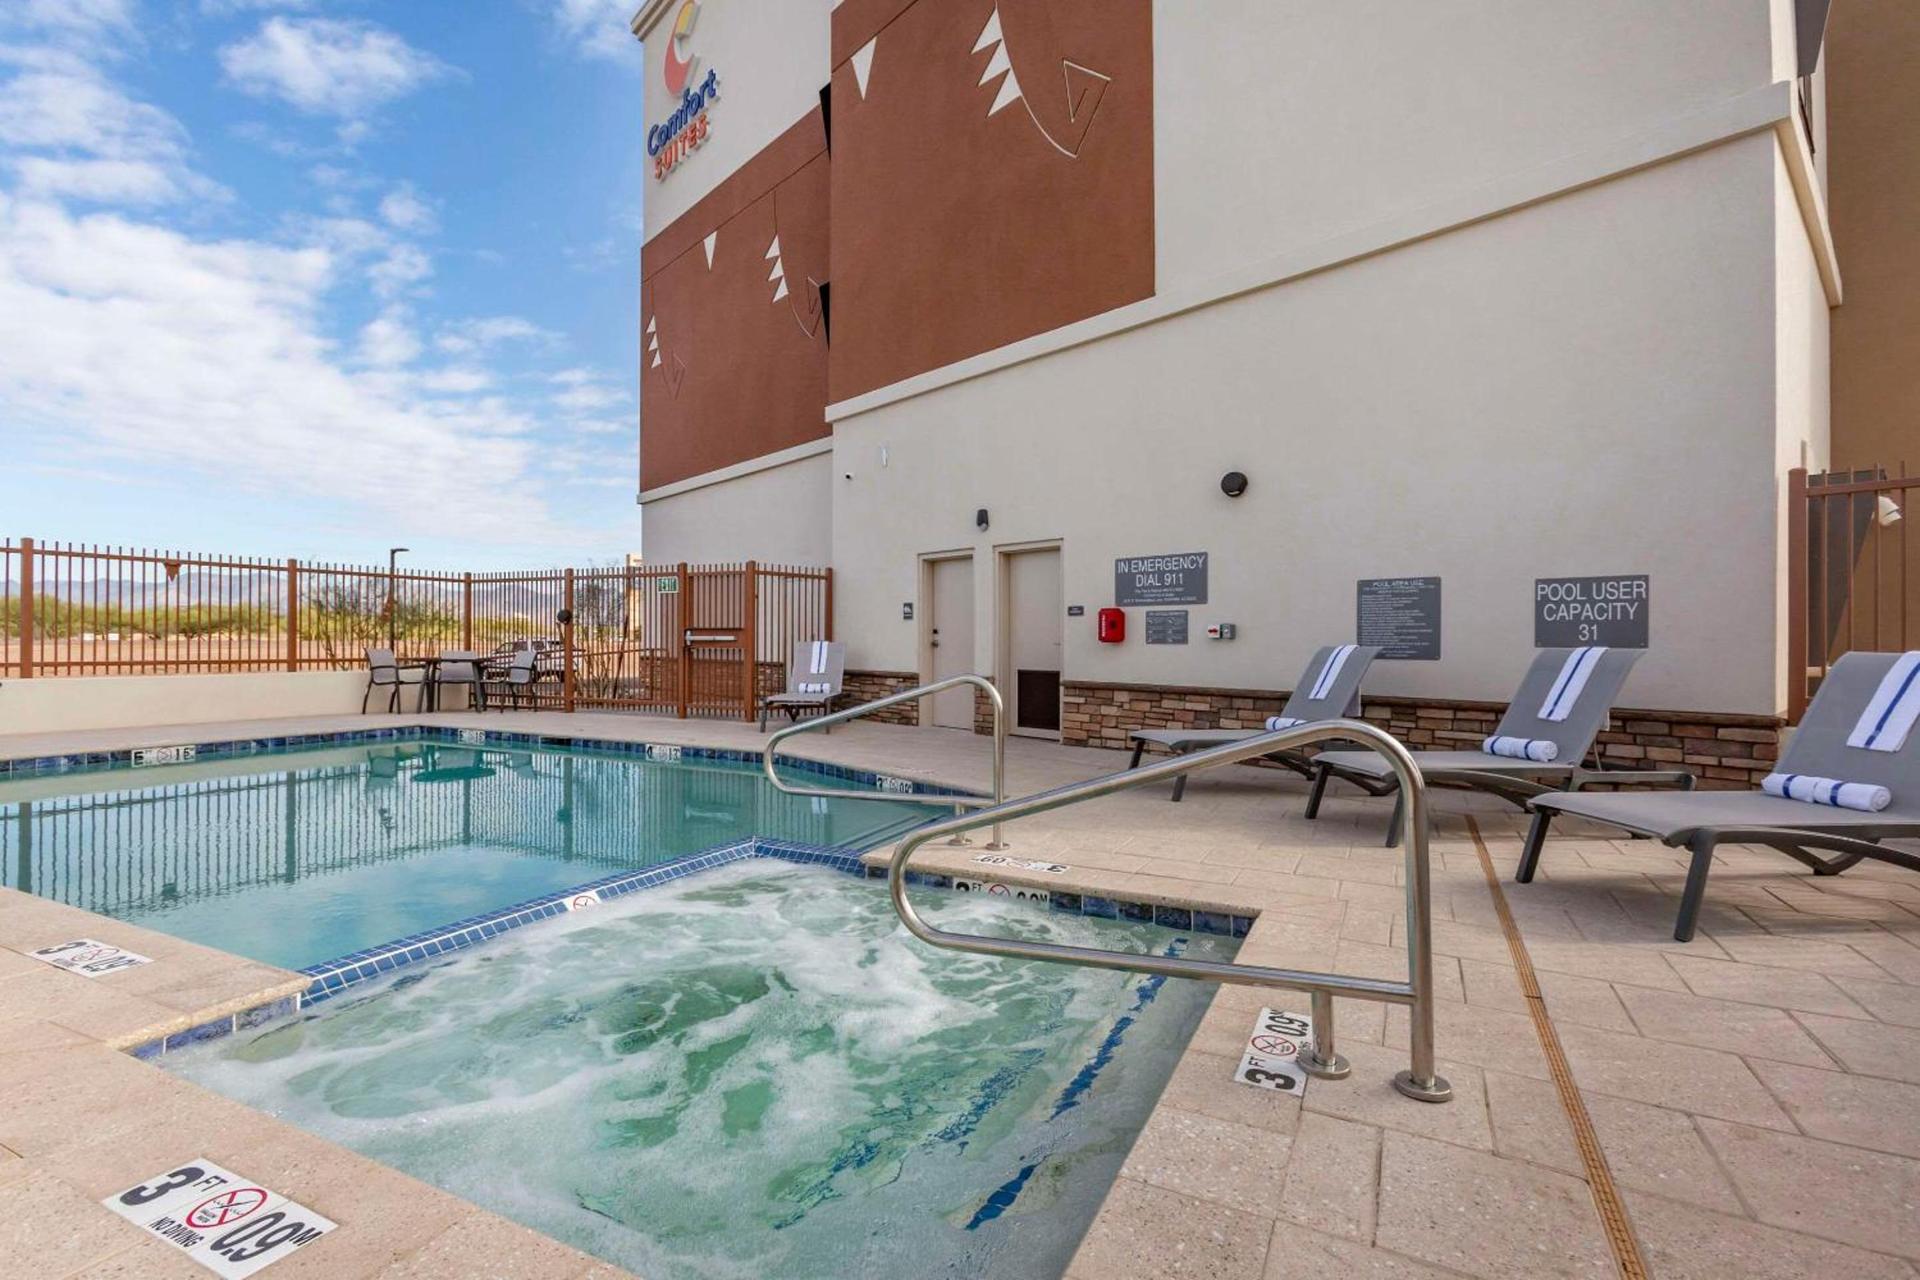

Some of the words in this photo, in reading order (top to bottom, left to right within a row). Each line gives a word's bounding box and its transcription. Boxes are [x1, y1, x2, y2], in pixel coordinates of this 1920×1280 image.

[647, 68, 716, 156] Comfort
[654, 113, 708, 179] SUITES
[1117, 560, 1129, 573] IN
[1131, 555, 1205, 573] EMERGENCY
[1135, 574, 1162, 587] DIAL
[1163, 573, 1183, 586] 911
[1537, 583, 1588, 601] POOL
[1592, 580, 1647, 599] USER
[1543, 602, 1639, 621] CAPACITY
[1578, 624, 1598, 641] 31
[1248, 1056, 1266, 1068] FT
[1244, 1068, 1297, 1091] 3
[119, 1167, 206, 1206] 3
[192, 1175, 228, 1192] FT
[148, 1216, 175, 1232] NO
[163, 1221, 204, 1248] DIVING
